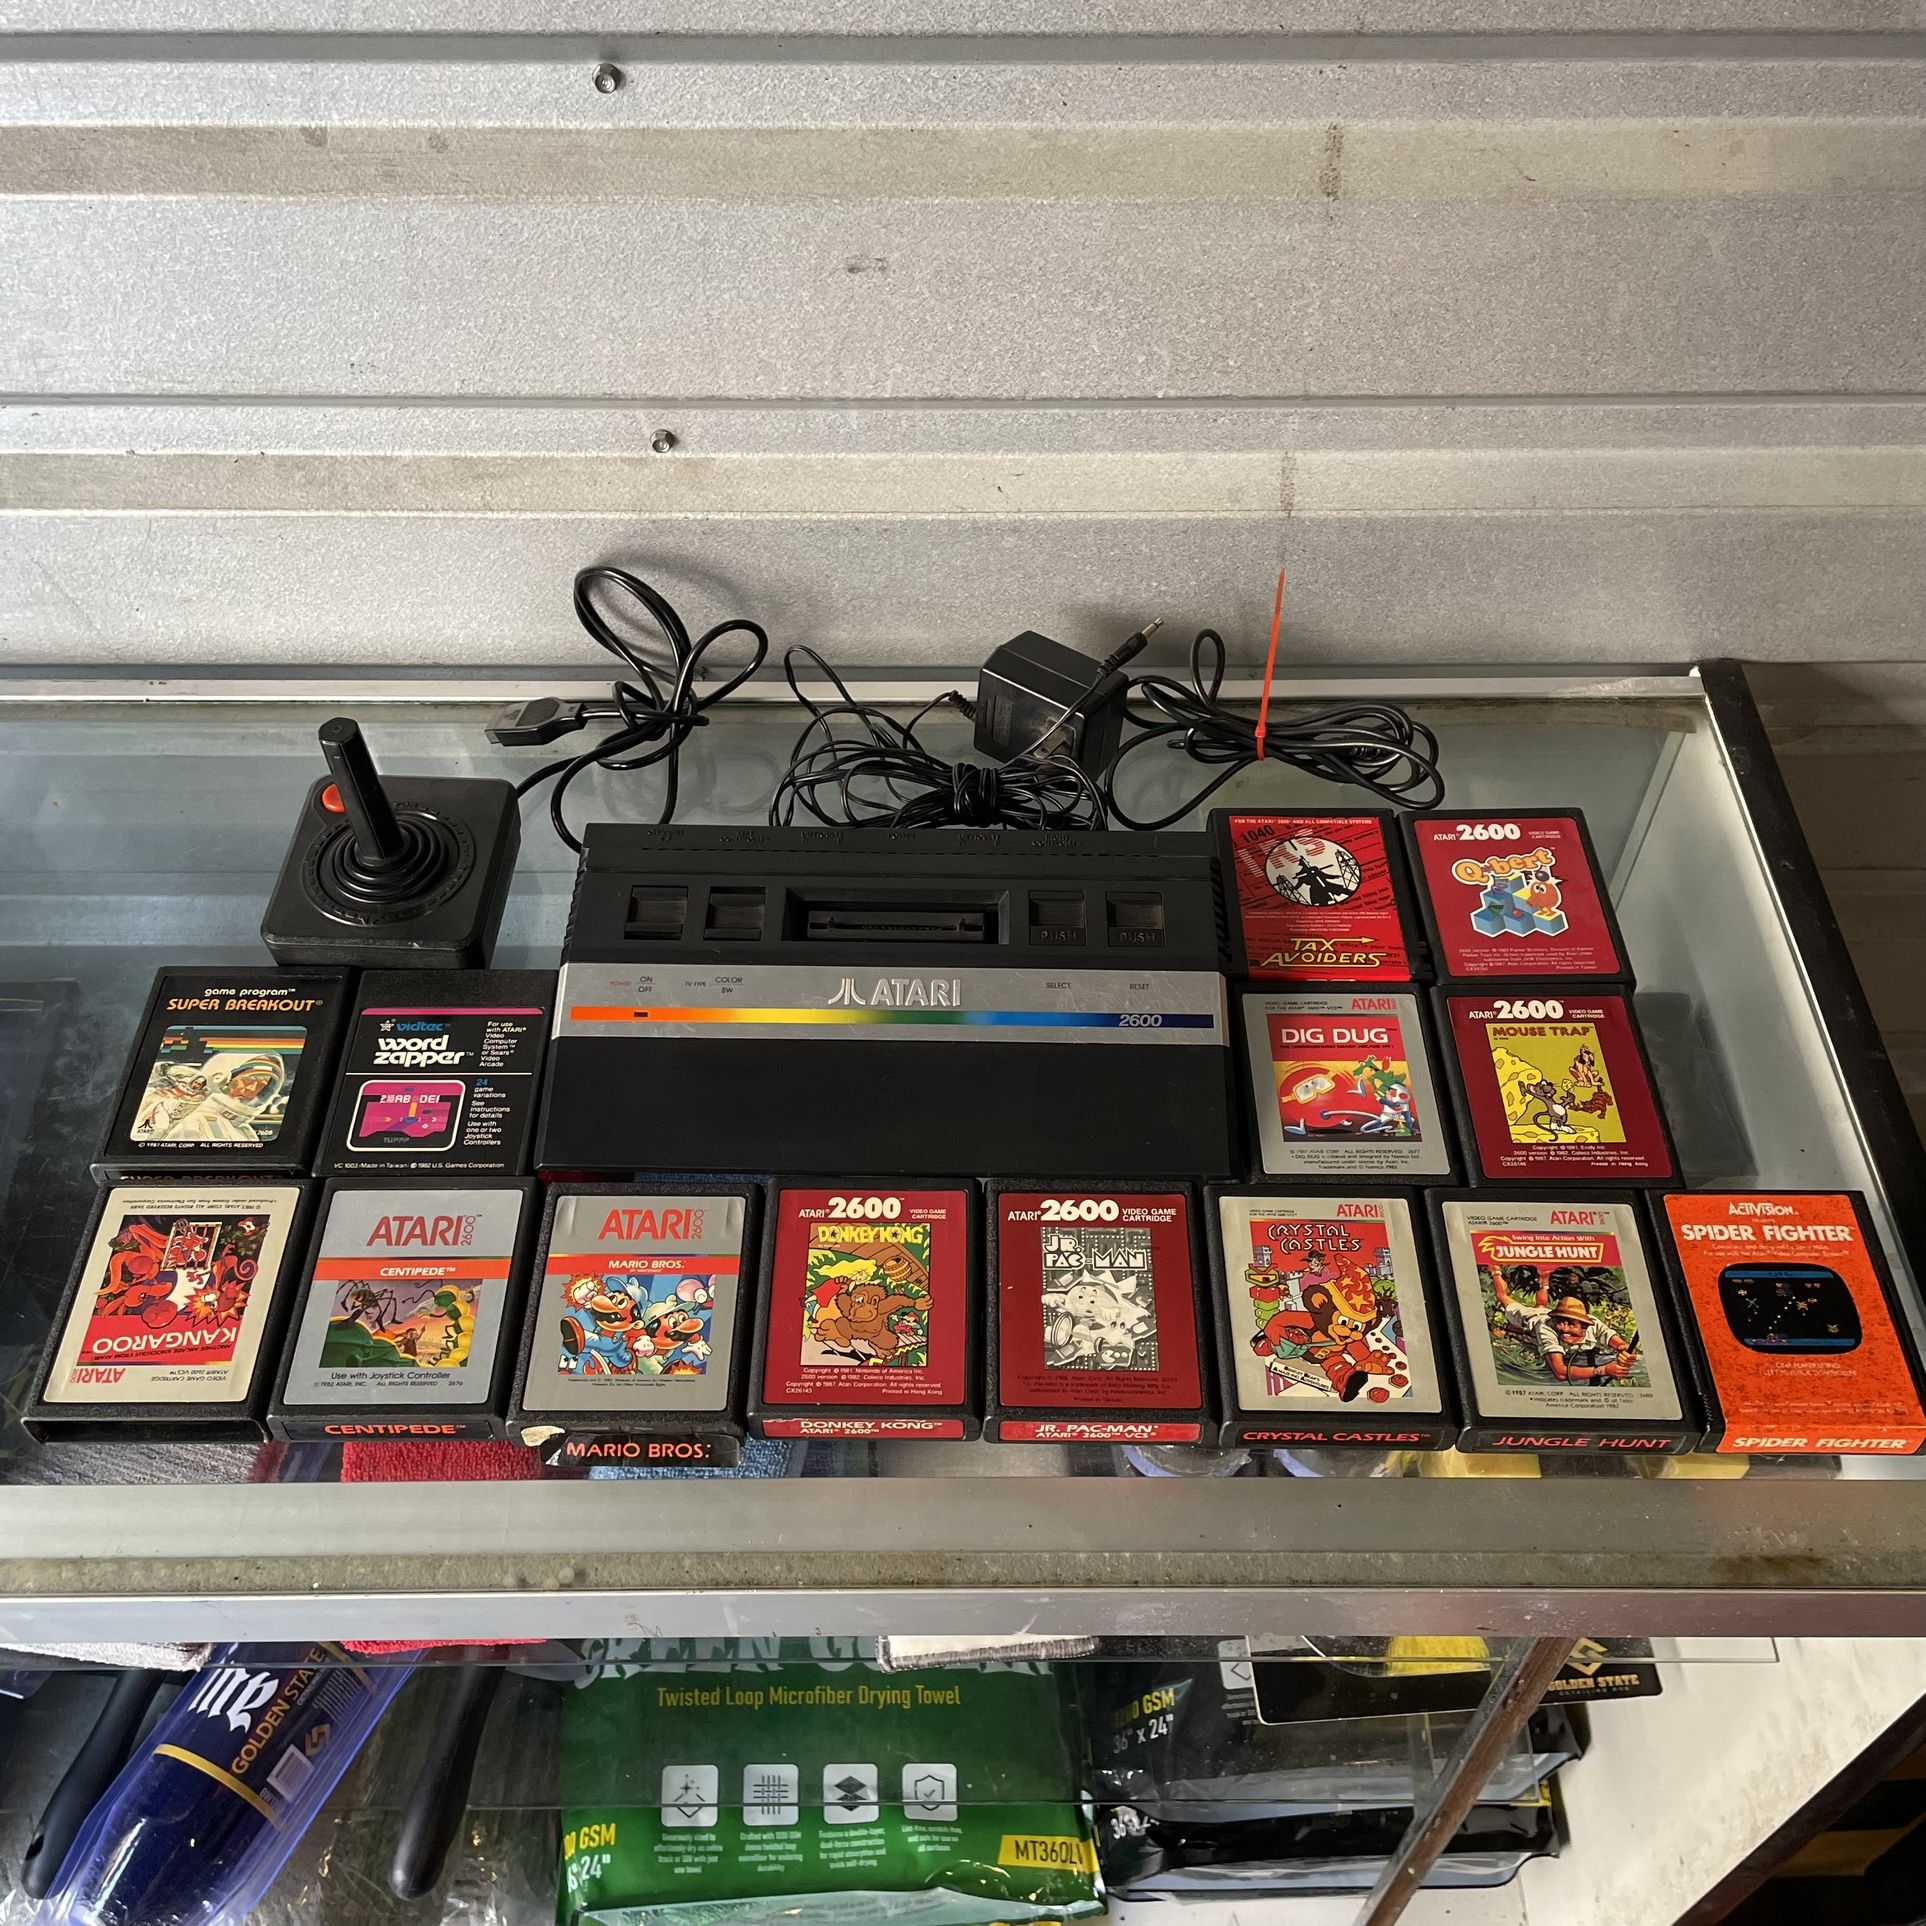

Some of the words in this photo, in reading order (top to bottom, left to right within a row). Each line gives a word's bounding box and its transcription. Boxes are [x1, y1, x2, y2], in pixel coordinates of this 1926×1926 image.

[1241, 825, 1274, 843] 1040
[1456, 824, 1521, 840] 2600
[1290, 937, 1336, 951] TAX
[1260, 953, 1387, 967] AVOIDERS
[204, 988, 236, 997] game
[870, 977, 962, 1007] ATARI
[167, 999, 219, 1011] SUPER
[1351, 998, 1390, 1010] ATARI
[1494, 1000, 1563, 1019] 2600
[1118, 1014, 1162, 1027] 2600
[1281, 1028, 1325, 1043] DIG
[1333, 1028, 1388, 1043] DUG
[1493, 1027, 1546, 1036] MOUSE
[1549, 1027, 1590, 1036] TRAP
[378, 1035, 449, 1050] word
[827, 1197, 901, 1219] 2600
[1040, 1199, 1119, 1222] 2600
[1337, 1204, 1379, 1218] ATARI
[366, 1215, 464, 1246] ATARI
[598, 1209, 691, 1240] ATARI
[1268, 1224, 1351, 1240] CRYSTAL
[818, 1226, 875, 1243] DONKEY
[880, 1226, 923, 1243] KONG
[1512, 1234, 1534, 1242] Swing
[1552, 1234, 1575, 1242] Action
[1576, 1234, 1595, 1242] With
[1681, 1224, 1756, 1241] SPIDER
[1764, 1226, 1853, 1242] FIGHTER
[1043, 1234, 1082, 1252] JR.
[1280, 1237, 1361, 1254] CASTLES
[1044, 1249, 1147, 1270] PAC-MAN
[1495, 1245, 1554, 1259] JUNGLE
[1557, 1245, 1599, 1259] HUNT
[608, 1260, 649, 1269] MARIO
[651, 1260, 686, 1269] BROS.
[92, 1326, 237, 1354] KANGAROO
[78, 1367, 125, 1384] ATARI
[331, 1372, 347, 1380] Use
[350, 1372, 368, 1380] with
[369, 1372, 405, 1380] Joystick
[407, 1372, 451, 1380] Controller
[800, 1421, 875, 1429] DONKEY
[1035, 1424, 1061, 1432] JR.
[1242, 1432, 1327, 1441] CRYSTAL
[1493, 1437, 1591, 1447] JUNGLE
[1600, 1438, 1672, 1448] HUNT
[1733, 1438, 1808, 1448] SPIDER
[1816, 1438, 1909, 1448] FIGHTER
[566, 1442, 641, 1457] MARIO
[1597, 1674, 1640, 1687] STATE
[657, 1686, 720, 1707] Twisted
[725, 1686, 764, 1710] Loop
[769, 1686, 852, 1705] Microfiber
[858, 1685, 911, 1709] Drying
[916, 1685, 961, 1705] Towel
[1143, 1688, 1175, 1714] GSM
[232, 1698, 290, 1774] GOLDEN
[579, 1823, 616, 1850] GSM
